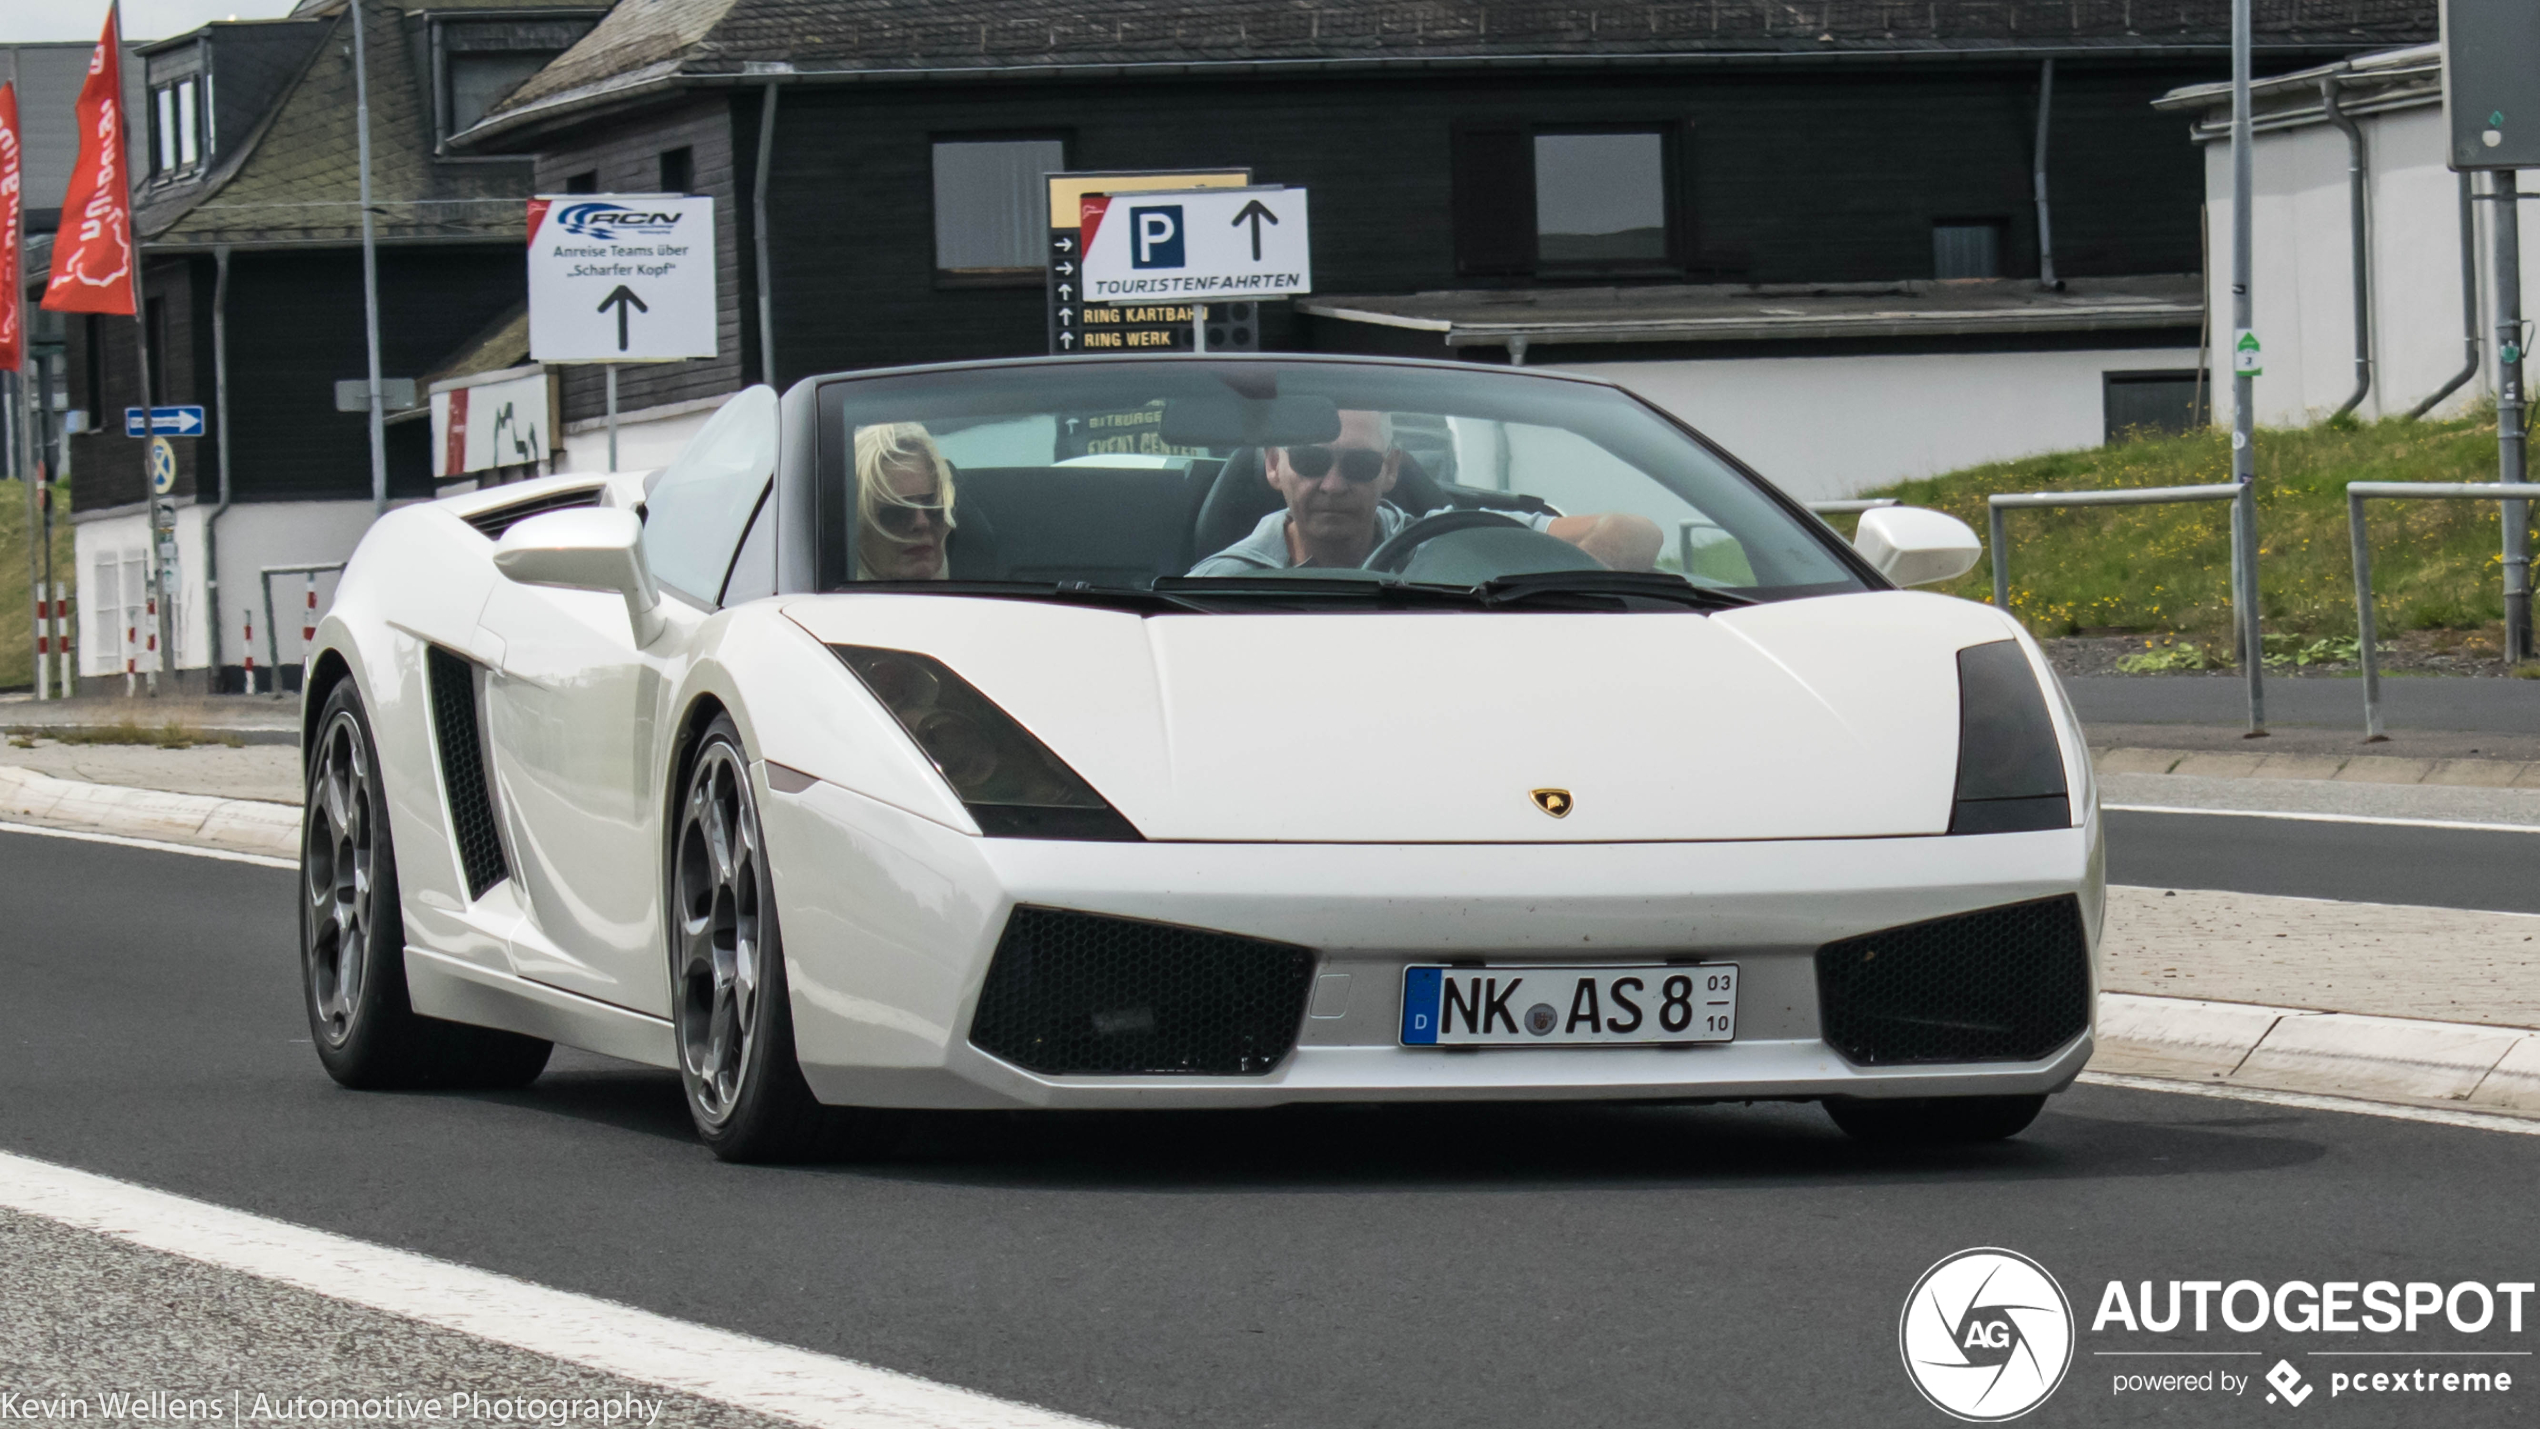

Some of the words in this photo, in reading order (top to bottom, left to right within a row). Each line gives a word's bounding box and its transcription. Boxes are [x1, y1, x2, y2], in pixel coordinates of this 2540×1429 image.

[589, 212, 683, 225] RCN
[1139, 213, 1175, 262] P
[553, 245, 607, 257] Anreise
[610, 245, 654, 257] Teams
[657, 244, 689, 257] über
[1096, 273, 1300, 295] TOURISTENFAHRTEN
[1083, 309, 1121, 323] RING
[1084, 333, 1122, 347] RING
[1126, 331, 1171, 346] WERK
[1707, 975, 1731, 991] 03
[1441, 977, 1524, 1034] NK
[1414, 1014, 1428, 1030] D
[1706, 1015, 1729, 1032] 10
